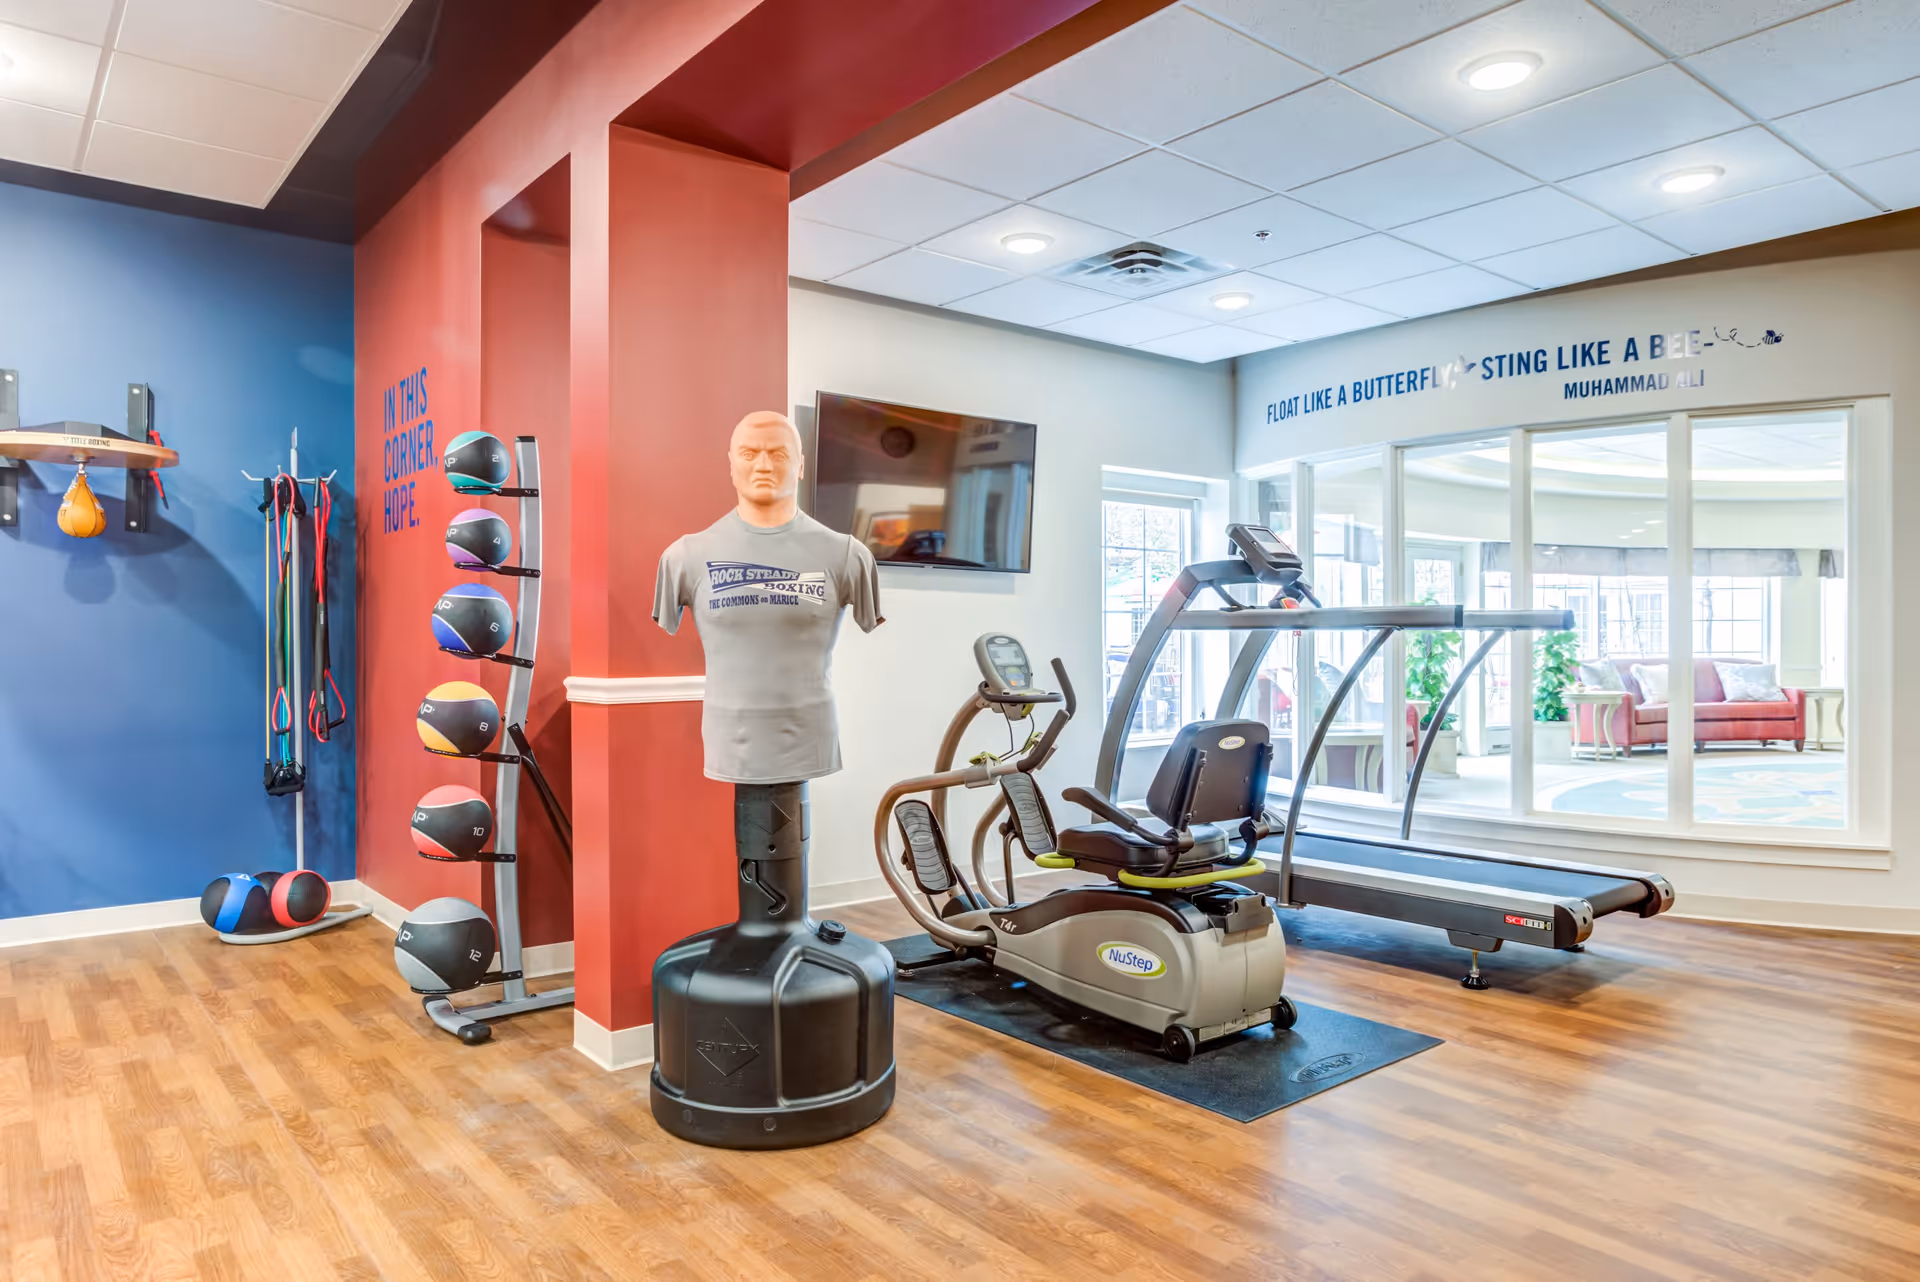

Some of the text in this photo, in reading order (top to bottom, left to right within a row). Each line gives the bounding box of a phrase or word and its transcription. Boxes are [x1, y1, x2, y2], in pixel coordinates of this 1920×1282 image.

[1267, 395, 1300, 424] FLOAT
[1304, 387, 1333, 414] LIKE
[1337, 384, 1347, 407] A
[1481, 349, 1548, 380] STING
[1557, 340, 1611, 370] LIKE
[1623, 337, 1640, 363] A
[1563, 373, 1669, 400] MUHAMMAD
[384, 366, 428, 433] IN THIS
[491, 454, 500, 463] 2
[492, 536, 501, 545] 4
[710, 568, 800, 586] ROCK STEADY
[763, 582, 825, 598] BOXING
[709, 599, 720, 610] THE
[721, 594, 760, 608] COMMONS
[769, 594, 799, 605] MARICE
[489, 621, 500, 633] 6
[479, 722, 489, 732] 8
[472, 826, 485, 837] 10
[468, 949, 482, 962] 12
[1108, 947, 1154, 972] NuStep
